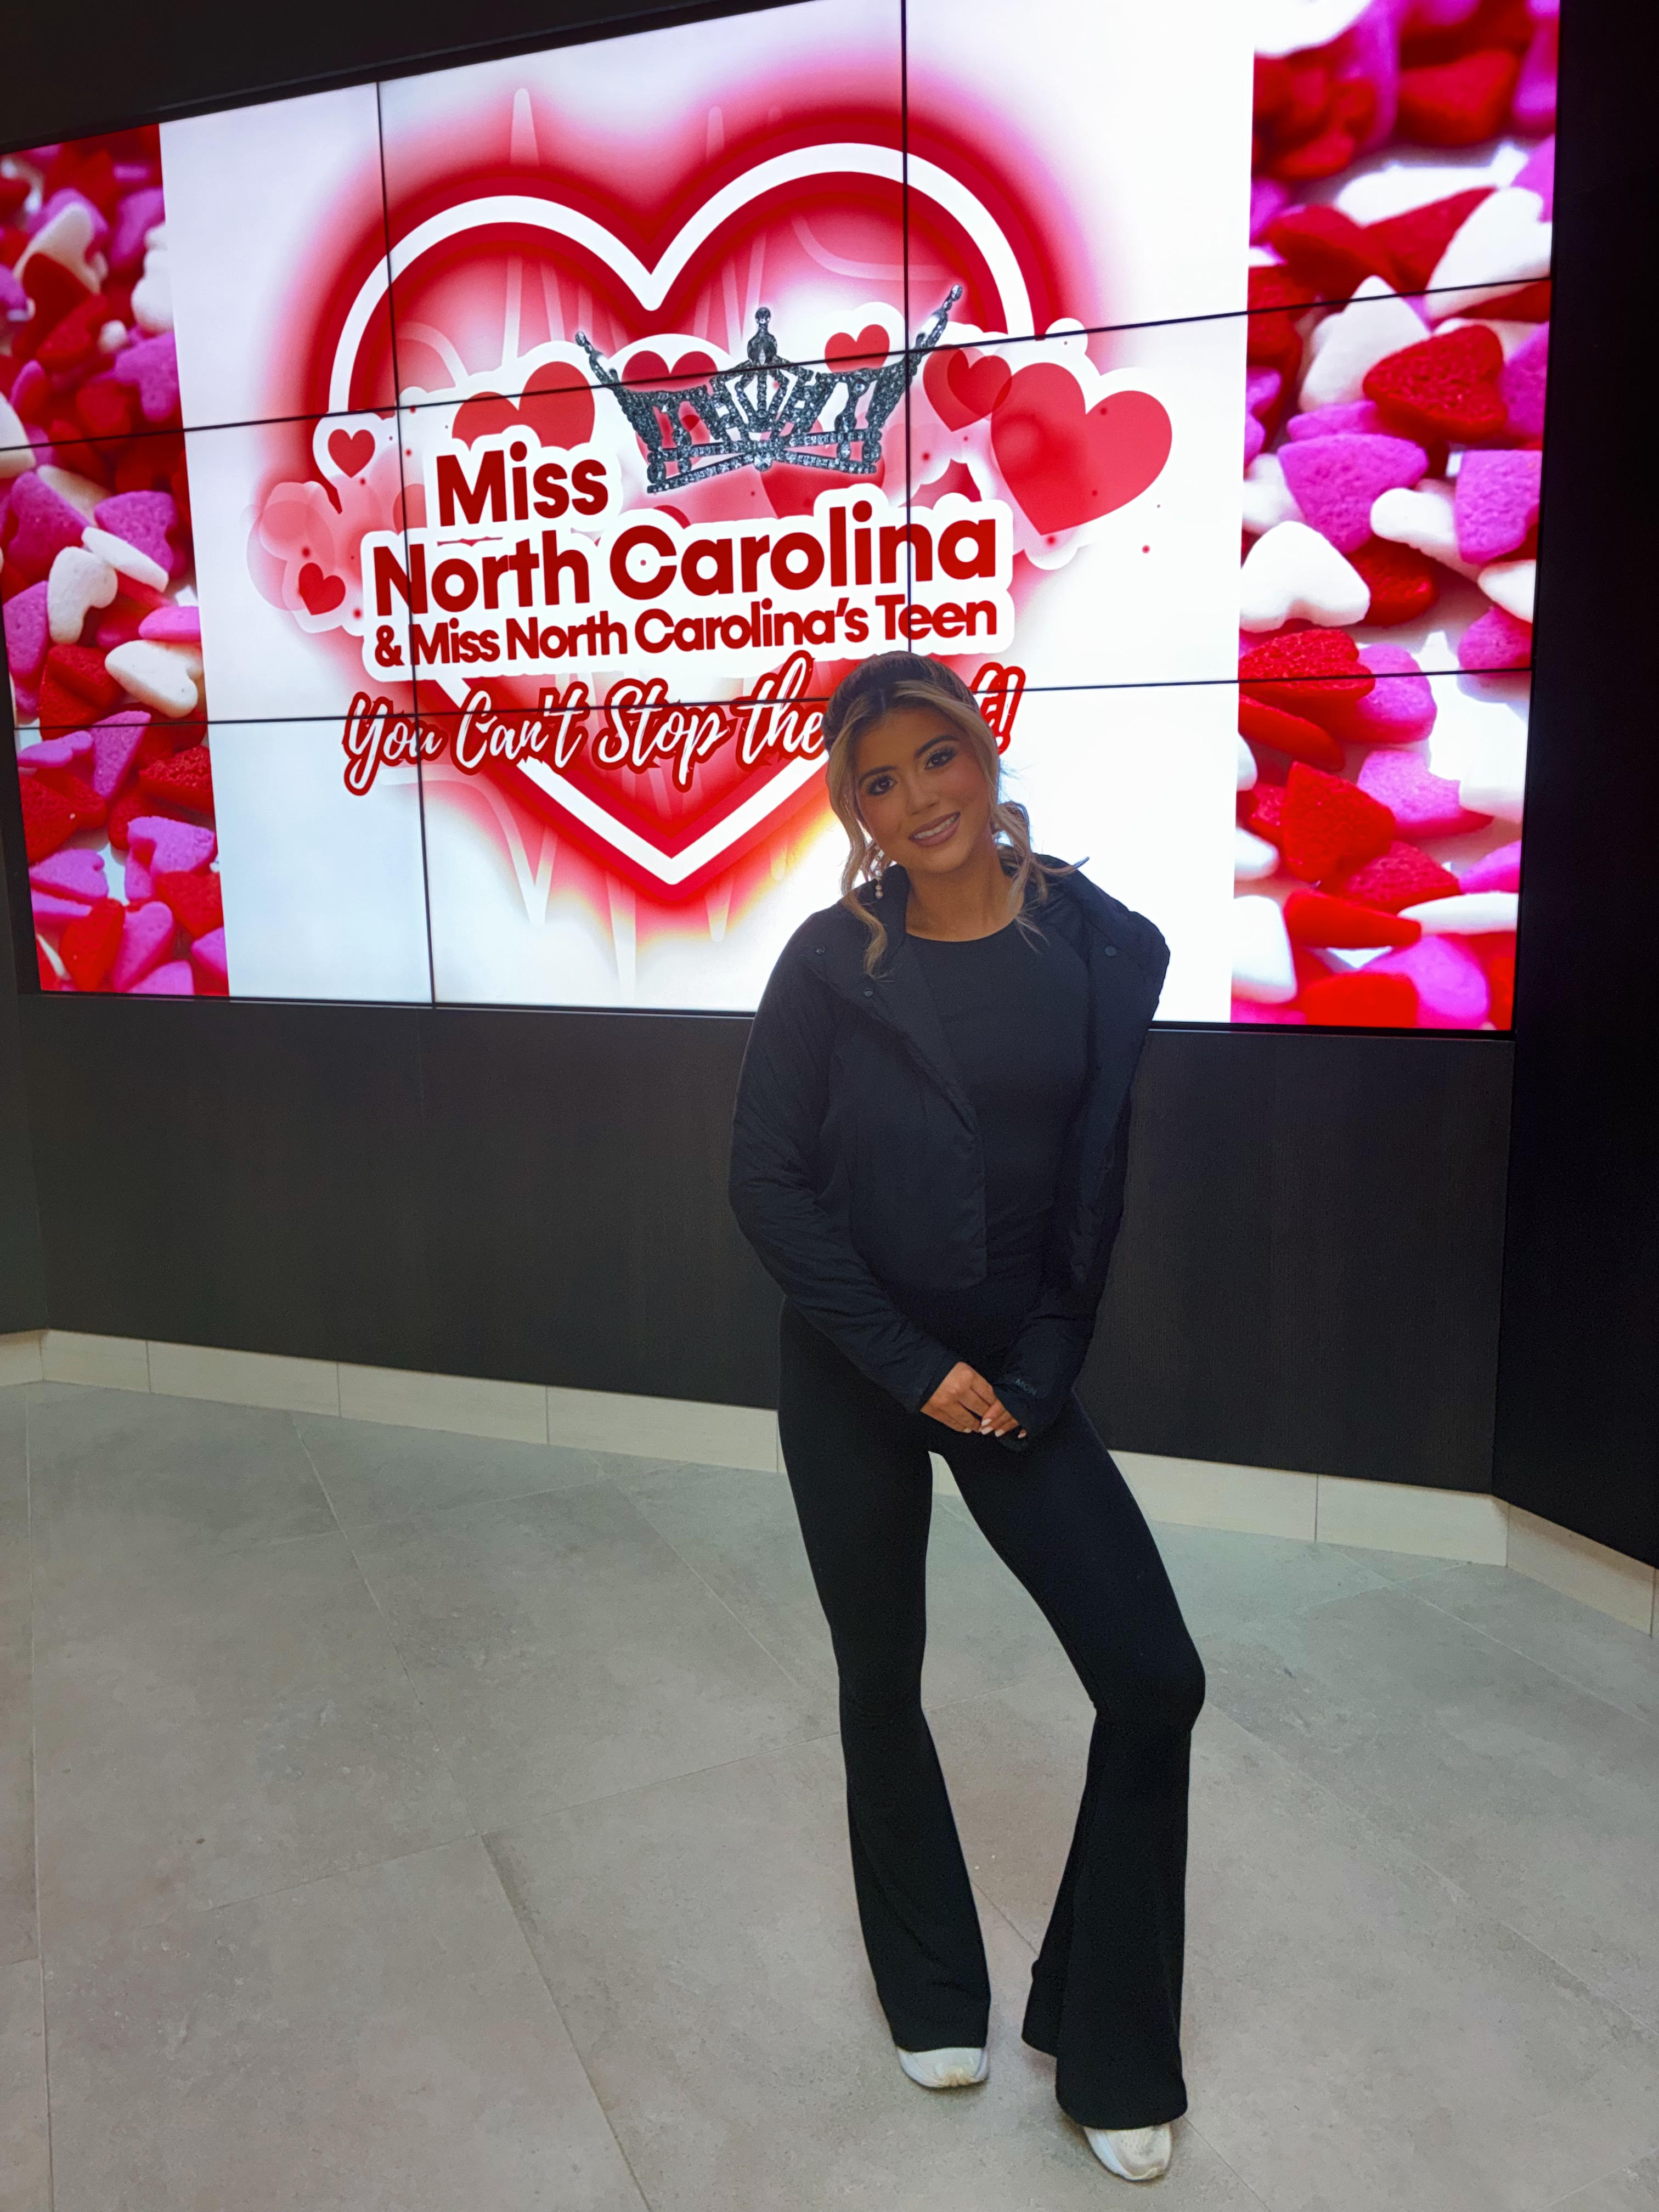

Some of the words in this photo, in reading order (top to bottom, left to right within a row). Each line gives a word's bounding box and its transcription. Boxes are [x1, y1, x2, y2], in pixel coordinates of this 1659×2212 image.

[436, 441, 608, 527] Miss
[373, 529, 590, 616] North
[610, 500, 996, 600] Carolina
[374, 624, 404, 667] &
[409, 617, 500, 668] Miss
[506, 610, 628, 660] North
[874, 594, 997, 644] Teen
[347, 696, 443, 791] You
[597, 684, 729, 786] Stop
[736, 656, 824, 765] the
